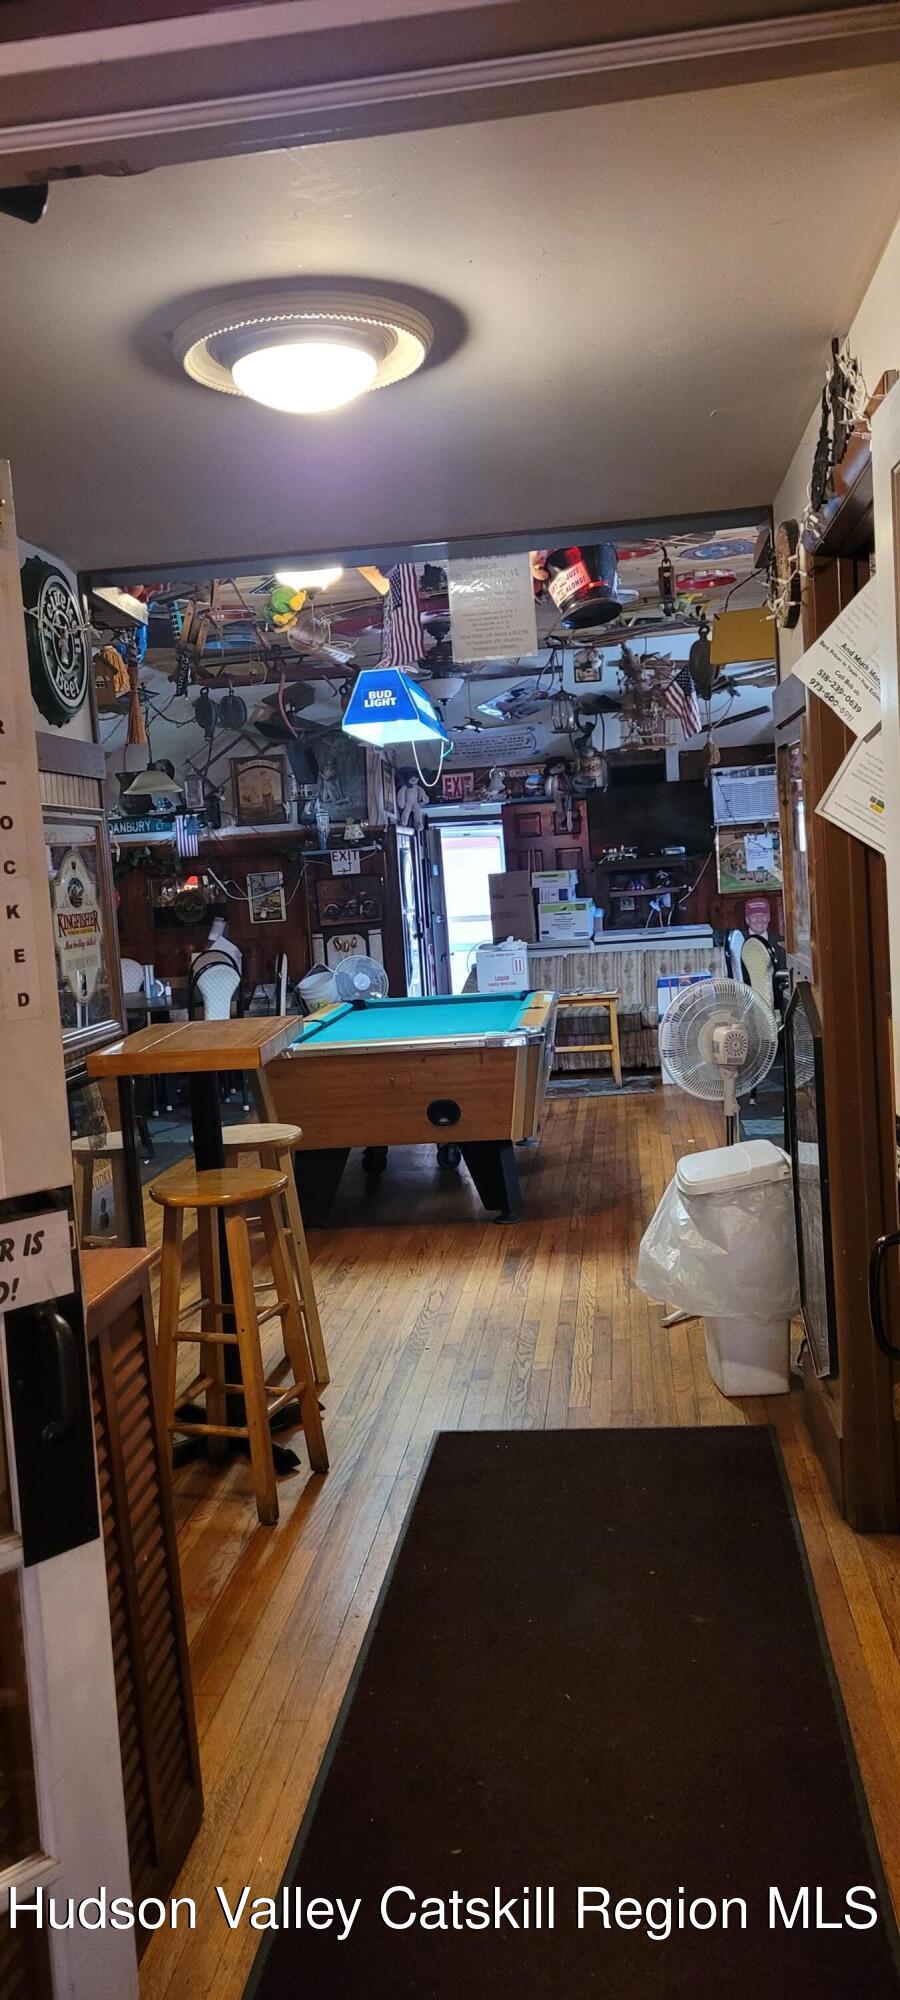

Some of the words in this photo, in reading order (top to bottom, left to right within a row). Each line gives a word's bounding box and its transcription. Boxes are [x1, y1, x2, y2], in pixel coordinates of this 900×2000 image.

[841, 642, 854, 657] And
[854, 654, 869, 672] Much
[55, 665, 80, 698] Beer
[368, 690, 392, 700] BUD
[817, 668, 862, 713] 518-239-0639
[364, 697, 397, 708] LIGHT
[332, 850, 357, 861] EXIT
[57, 910, 101, 938] KINGFISHER
[23, 1230, 45, 1257] IS
